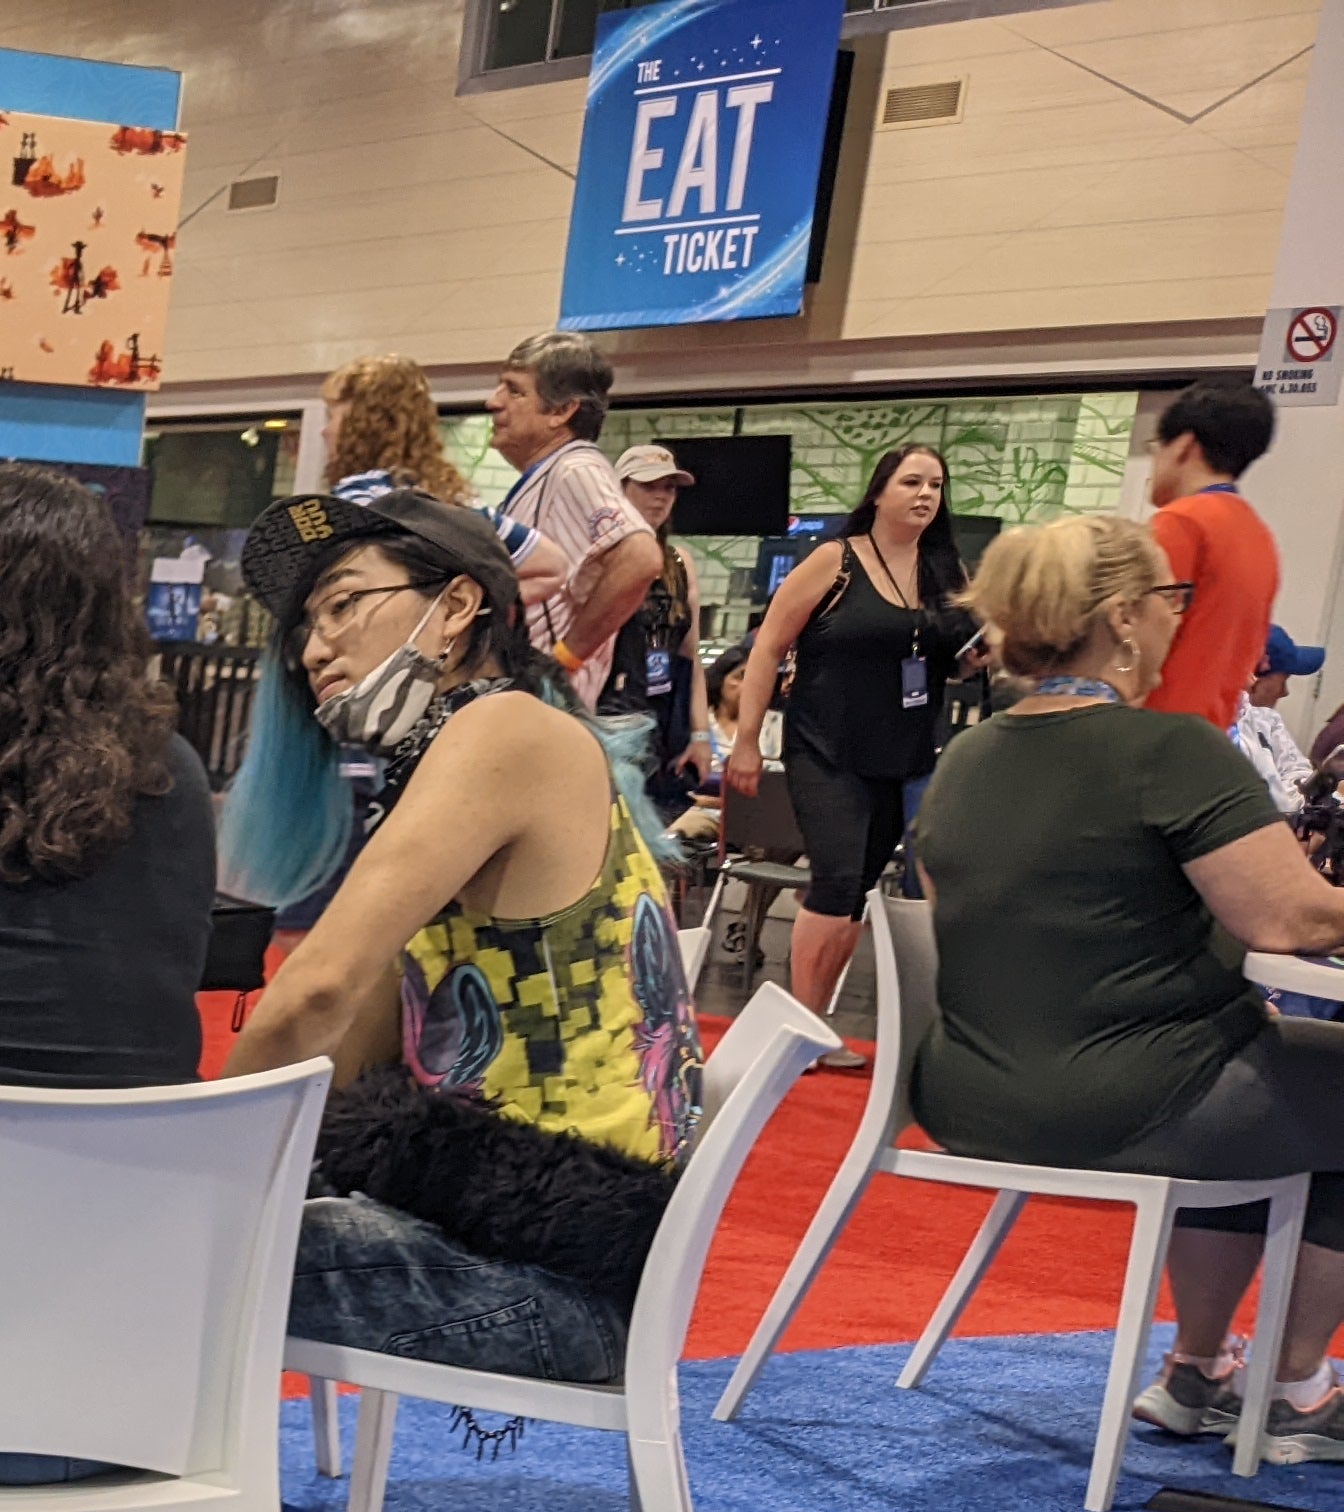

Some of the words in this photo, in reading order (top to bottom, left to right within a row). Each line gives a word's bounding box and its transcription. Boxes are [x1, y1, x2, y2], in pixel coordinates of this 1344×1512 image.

[637, 59, 663, 84] THE
[621, 80, 775, 223] EAT
[663, 225, 760, 276] TICKET
